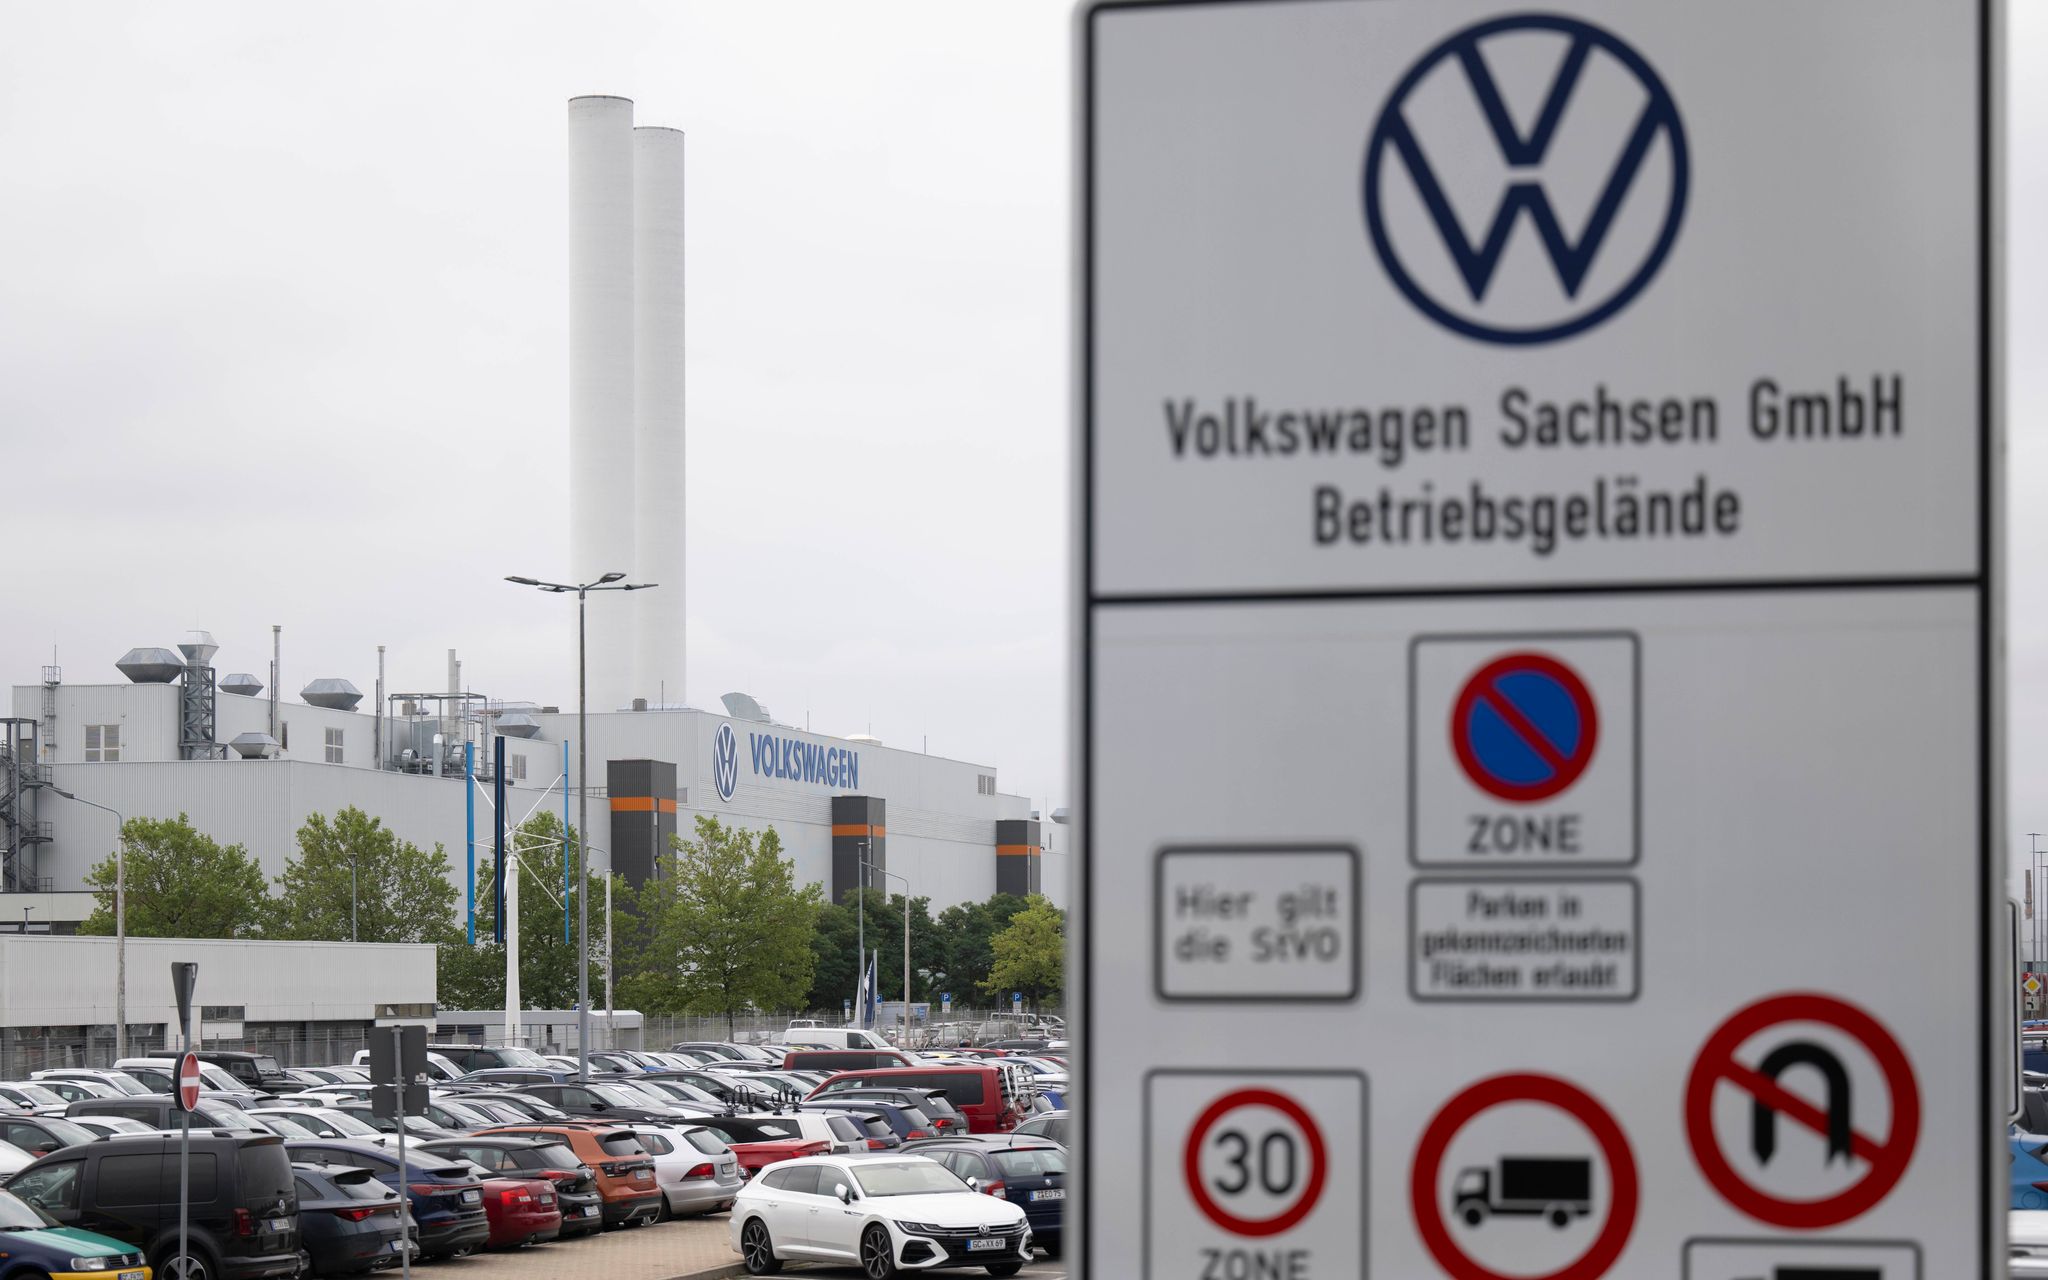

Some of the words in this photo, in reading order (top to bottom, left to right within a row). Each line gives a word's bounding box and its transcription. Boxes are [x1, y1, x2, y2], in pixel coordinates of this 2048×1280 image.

[1165, 399, 1470, 470] Volkswagen
[1500, 385, 1719, 448] Sachsen
[1750, 375, 1903, 441] GmbH
[1313, 473, 1741, 557] Betriebsgelände
[750, 732, 859, 790] VOLKSWAGEN
[1467, 814, 1580, 854] ZONE
[1175, 883, 1255, 920] Hier
[1277, 883, 1338, 930] gilt
[1466, 889, 1549, 919] Parken
[1558, 890, 1582, 919] in
[1174, 926, 1232, 962] die
[1250, 926, 1341, 963] StVO
[1420, 926, 1627, 960] gekennzeichneten
[1430, 959, 1520, 988] Flächen
[1533, 959, 1618, 989] erlaubt
[1214, 1128, 1297, 1197] 30
[1201, 1248, 1311, 1280] ZONE
